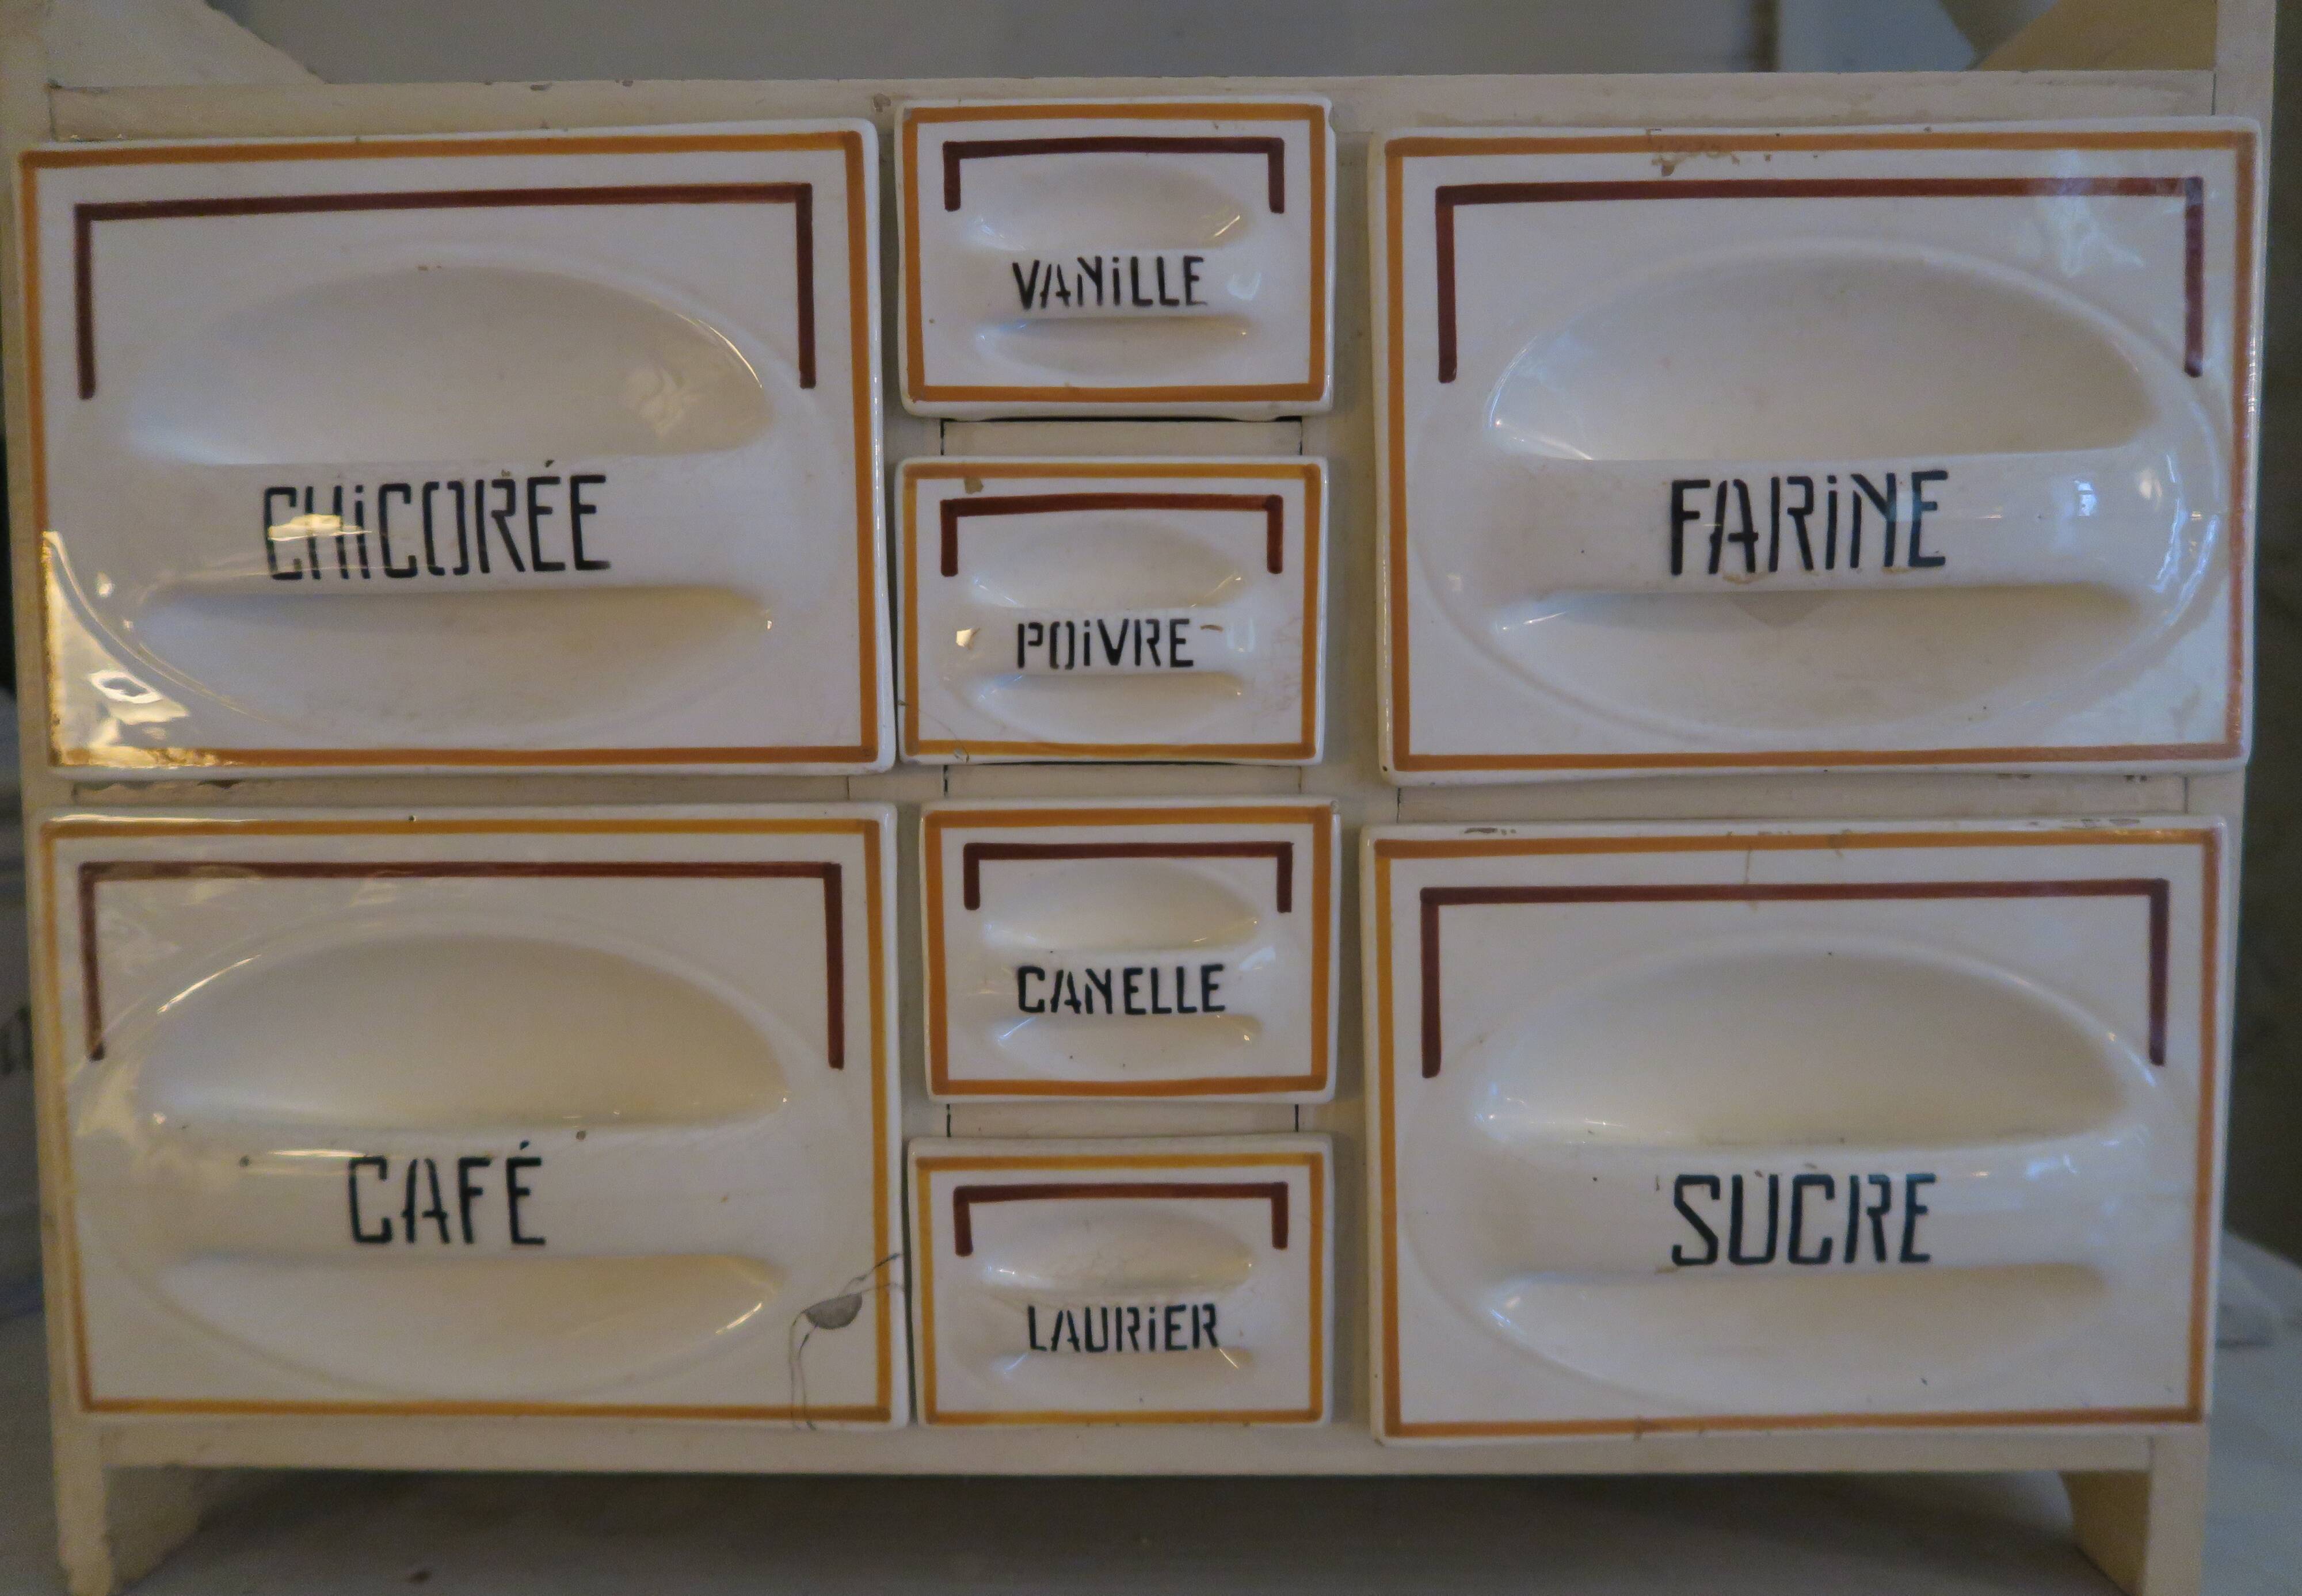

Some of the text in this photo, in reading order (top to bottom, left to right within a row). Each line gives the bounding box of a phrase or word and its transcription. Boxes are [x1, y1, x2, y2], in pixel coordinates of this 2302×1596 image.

[1016, 964, 1225, 1016] CANELLE
[348, 1141, 546, 1246] CAFÉ
[1671, 1174, 1935, 1267] SUCRE
